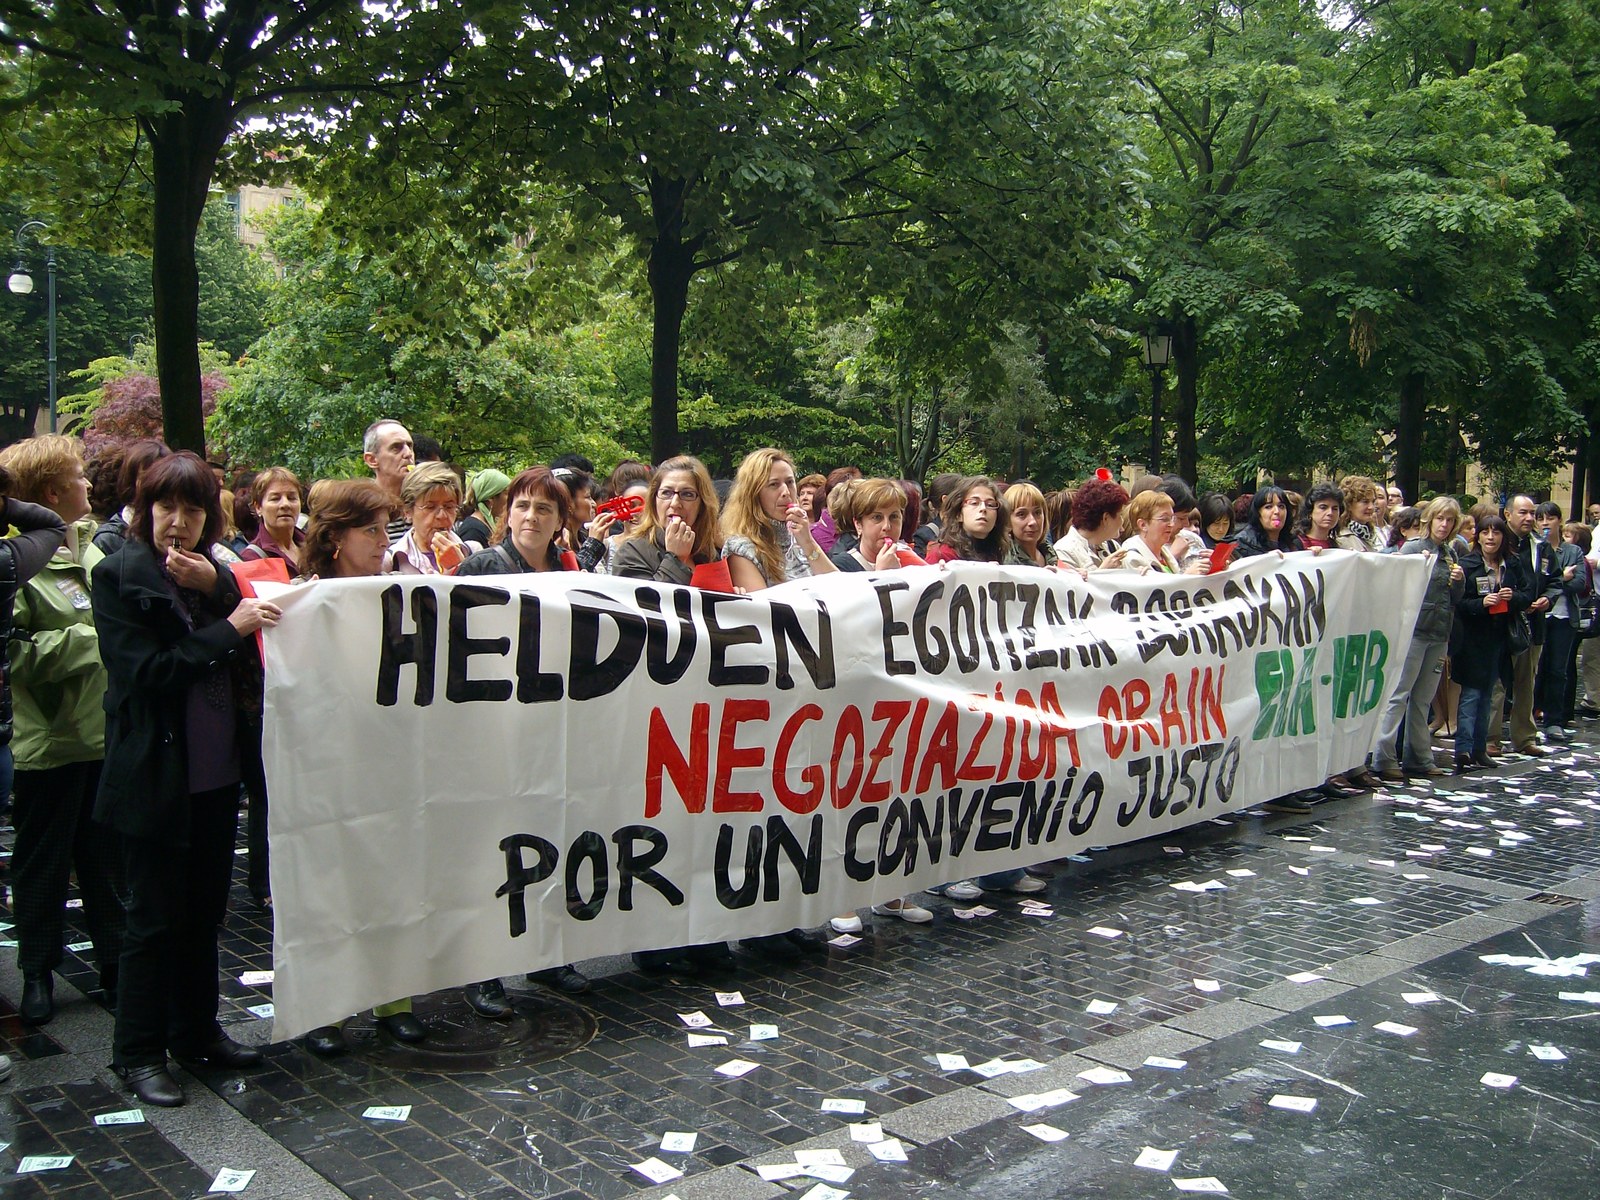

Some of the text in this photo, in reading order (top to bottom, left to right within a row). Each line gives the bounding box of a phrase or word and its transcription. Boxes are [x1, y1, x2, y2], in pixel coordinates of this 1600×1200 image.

[376, 583, 836, 706] HELDUEN
[870, 579, 1116, 676] EGOITZAK
[1098, 664, 1227, 760] ORAIN
[496, 825, 684, 937] POR
[714, 815, 821, 908] UN
[1117, 736, 1240, 826] JUSTO
